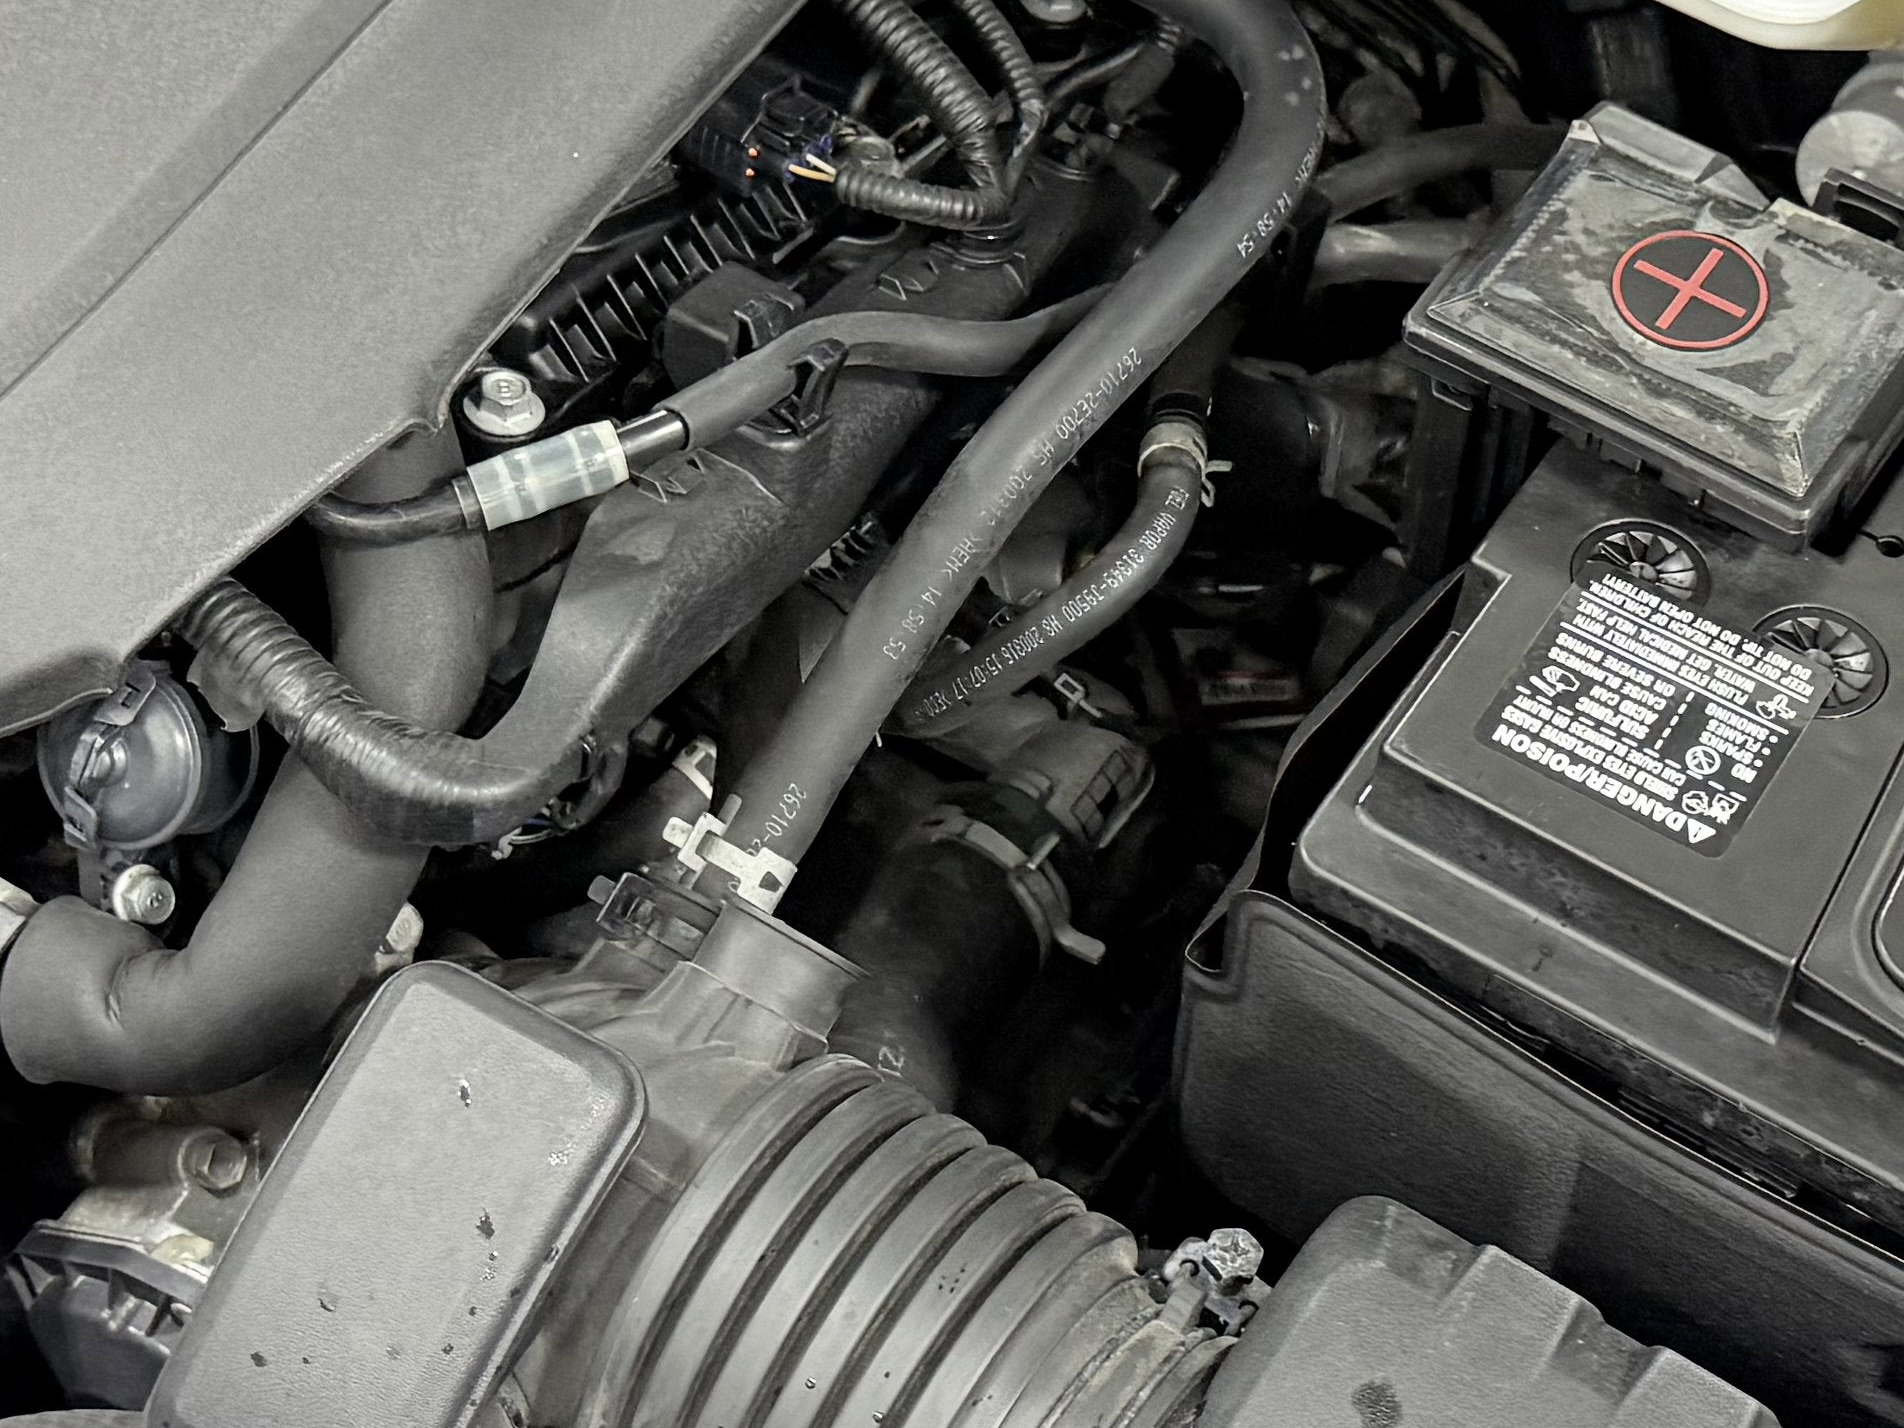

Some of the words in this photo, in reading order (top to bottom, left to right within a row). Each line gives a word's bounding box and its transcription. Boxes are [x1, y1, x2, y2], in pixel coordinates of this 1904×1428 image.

[1051, 346, 1145, 440] 26710-2E700
[1139, 507, 1176, 552] VAPOR
[1585, 578, 1652, 617] CHILDREN.
[1600, 571, 1661, 607] BATTERY!
[1574, 597, 1608, 621] FAST.
[1649, 608, 1670, 626] OF
[1657, 598, 1694, 623] OPEN
[1572, 612, 1606, 636] WITH
[1604, 611, 1638, 636] HELP
[1667, 617, 1712, 646] REACH
[1693, 615, 1721, 636] NOT
[1718, 627, 1741, 645] DO
[1554, 630, 1604, 663] BURNS
[1602, 626, 1681, 672] IMMEDIATELY
[1635, 626, 1689, 660] MEDICAL
[1708, 637, 1736, 658] THE
[1739, 637, 1765, 657] TIP.
[1546, 644, 1623, 690] BLINDNESS
[1601, 653, 1655, 688] SEVERE
[1686, 650, 1713, 672] GET
[1733, 649, 1753, 666] OF
[1751, 658, 1782, 680] OUT
[1763, 649, 1792, 670] NOT
[1789, 662, 1812, 680] DO
[1651, 678, 1677, 698] OR
[1677, 662, 1711, 686] EYES
[1710, 662, 1757, 693] WATER.
[1779, 672, 1815, 697] KEEP
[1588, 683, 1620, 707] CAN
[1619, 680, 1667, 712] CAUSE
[1707, 677, 1749, 705] FLUSH
[1500, 703, 1543, 734] GASES
[1512, 692, 1554, 721] INJURY
[1549, 711, 1571, 730] OR
[1573, 694, 1650, 740] SULFURIC
[1617, 697, 1659, 727] ACID
[1703, 700, 1769, 741] SMOKING
[1538, 722, 1606, 764] EXPLOSIVE
[1567, 719, 1629, 758] BLINDNESS
[1697, 728, 1755, 766] SPARKS
[1704, 716, 1762, 754] FLAMES
[1601, 753, 1637, 780] EYES
[1625, 748, 1664, 775] CAUSE
[1729, 761, 1757, 784] NO
[1490, 722, 1687, 832] DANGER/POISON
[1632, 768, 1679, 801] SHIELD
[1660, 766, 1687, 786] CAN
